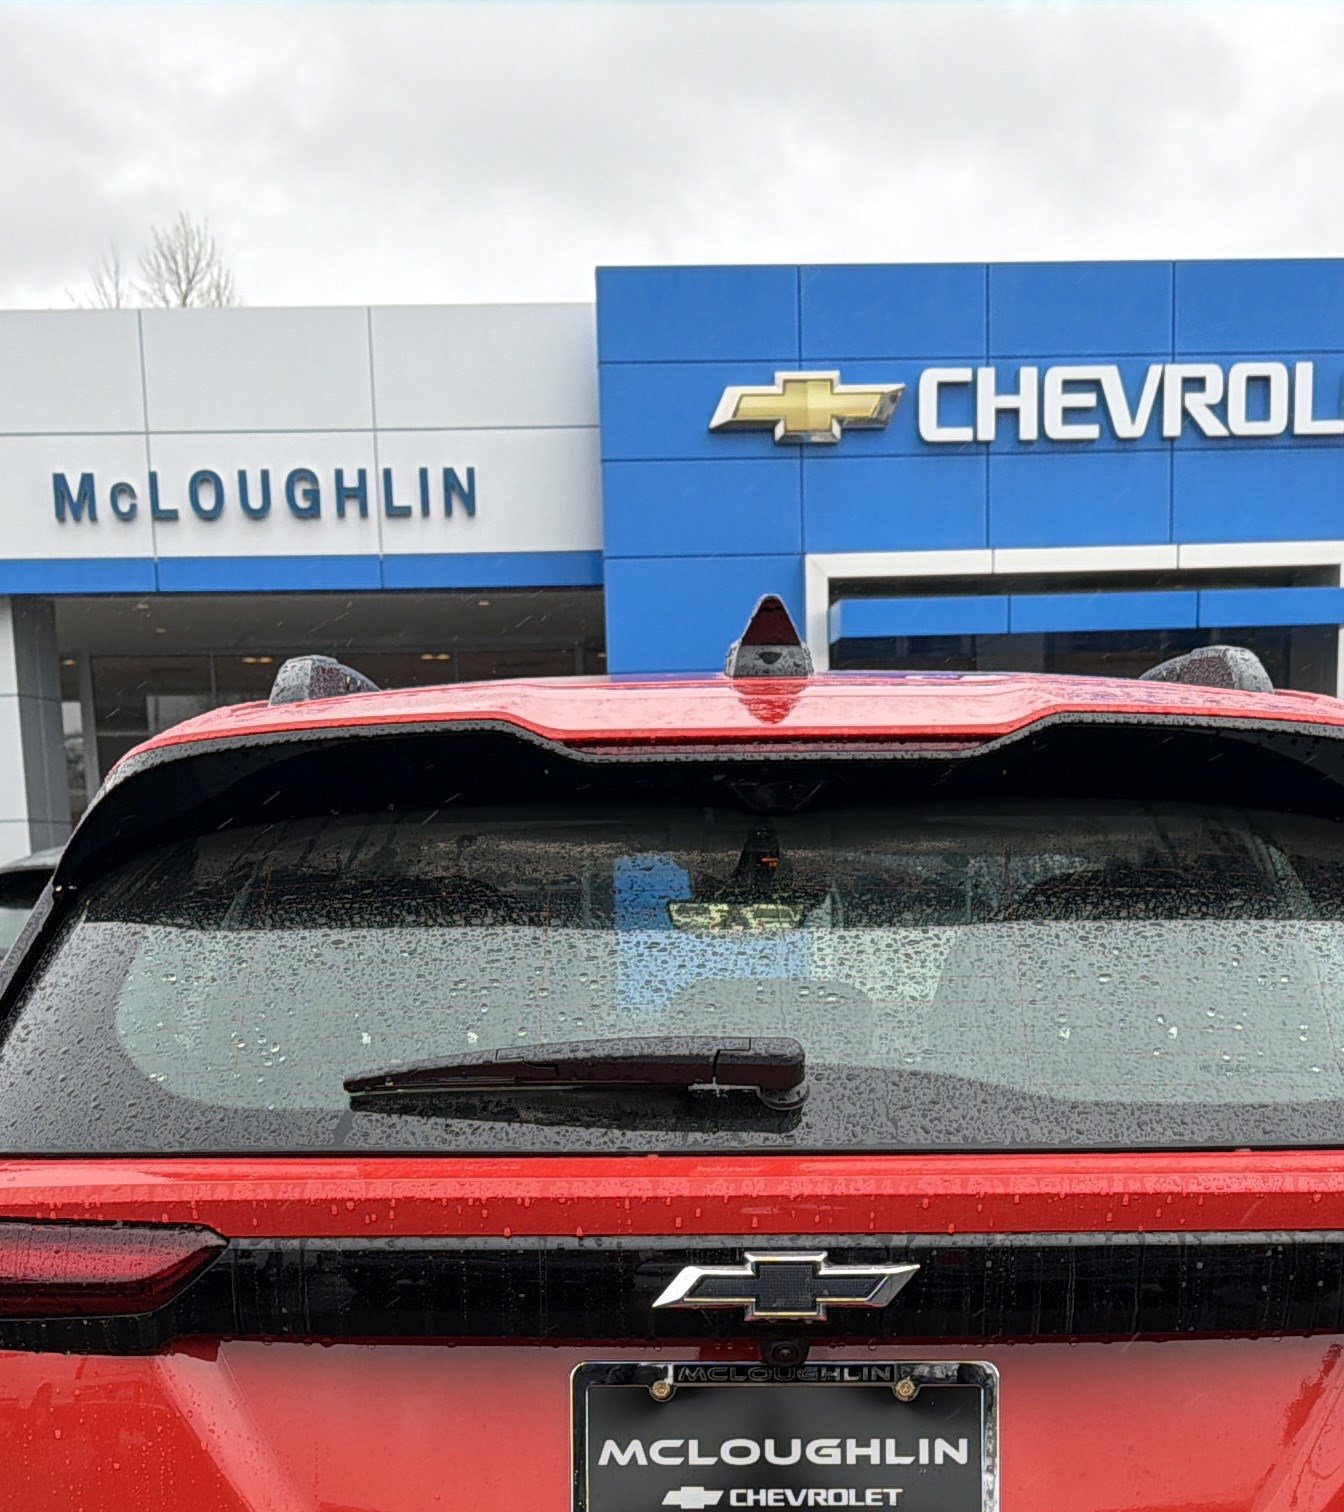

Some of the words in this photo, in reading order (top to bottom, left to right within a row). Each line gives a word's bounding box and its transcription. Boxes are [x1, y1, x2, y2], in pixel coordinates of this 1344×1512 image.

[53, 466, 477, 523] McLOUGHLIN
[677, 1365, 891, 1382] MCLOUGHLIN
[597, 1438, 968, 1466] MCLOUGHLIN
[729, 1488, 904, 1507] CHEVROLET
